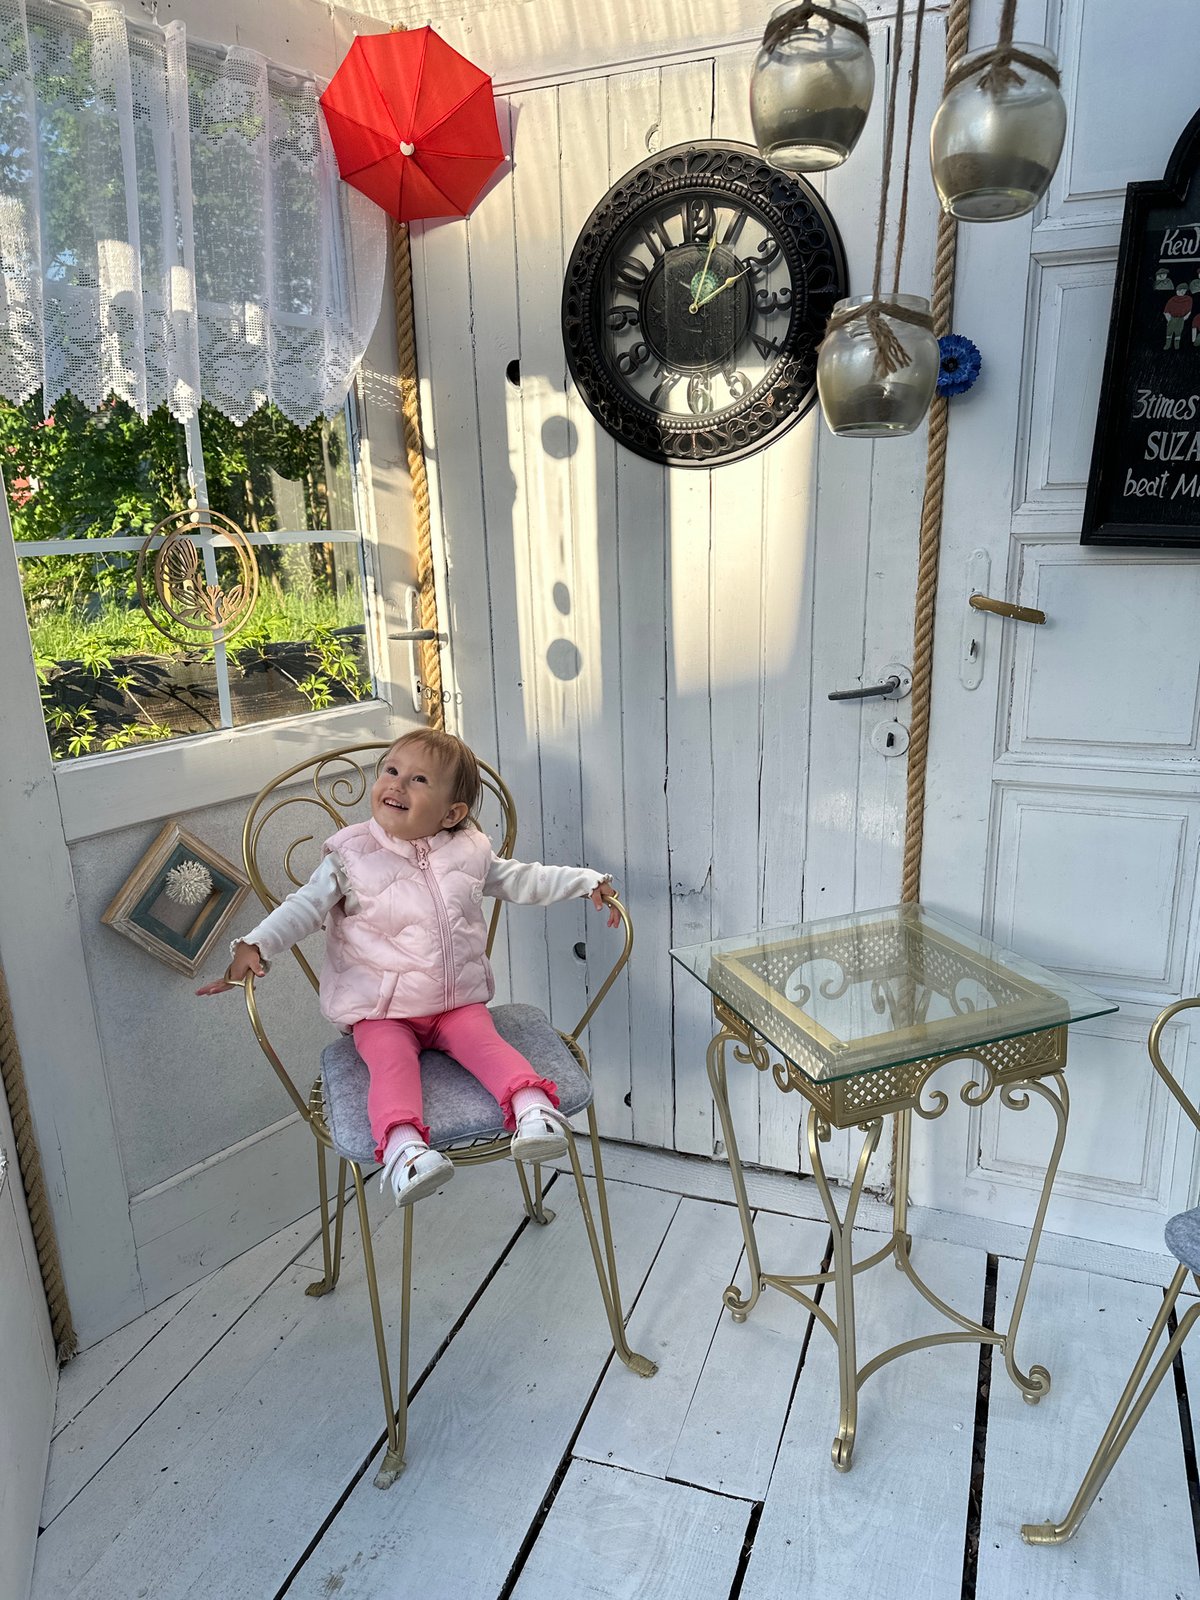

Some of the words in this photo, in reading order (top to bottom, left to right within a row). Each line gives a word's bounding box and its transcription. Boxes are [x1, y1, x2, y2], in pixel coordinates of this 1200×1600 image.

[681, 198, 716, 246] 12
[606, 305, 640, 332] 9
[754, 287, 794, 316] 3
[616, 341, 652, 376] 8
[747, 330, 787, 361] 4
[686, 372, 714, 416] 6
[1122, 467, 1170, 499] beat
[1170, 472, 1200, 501] M
